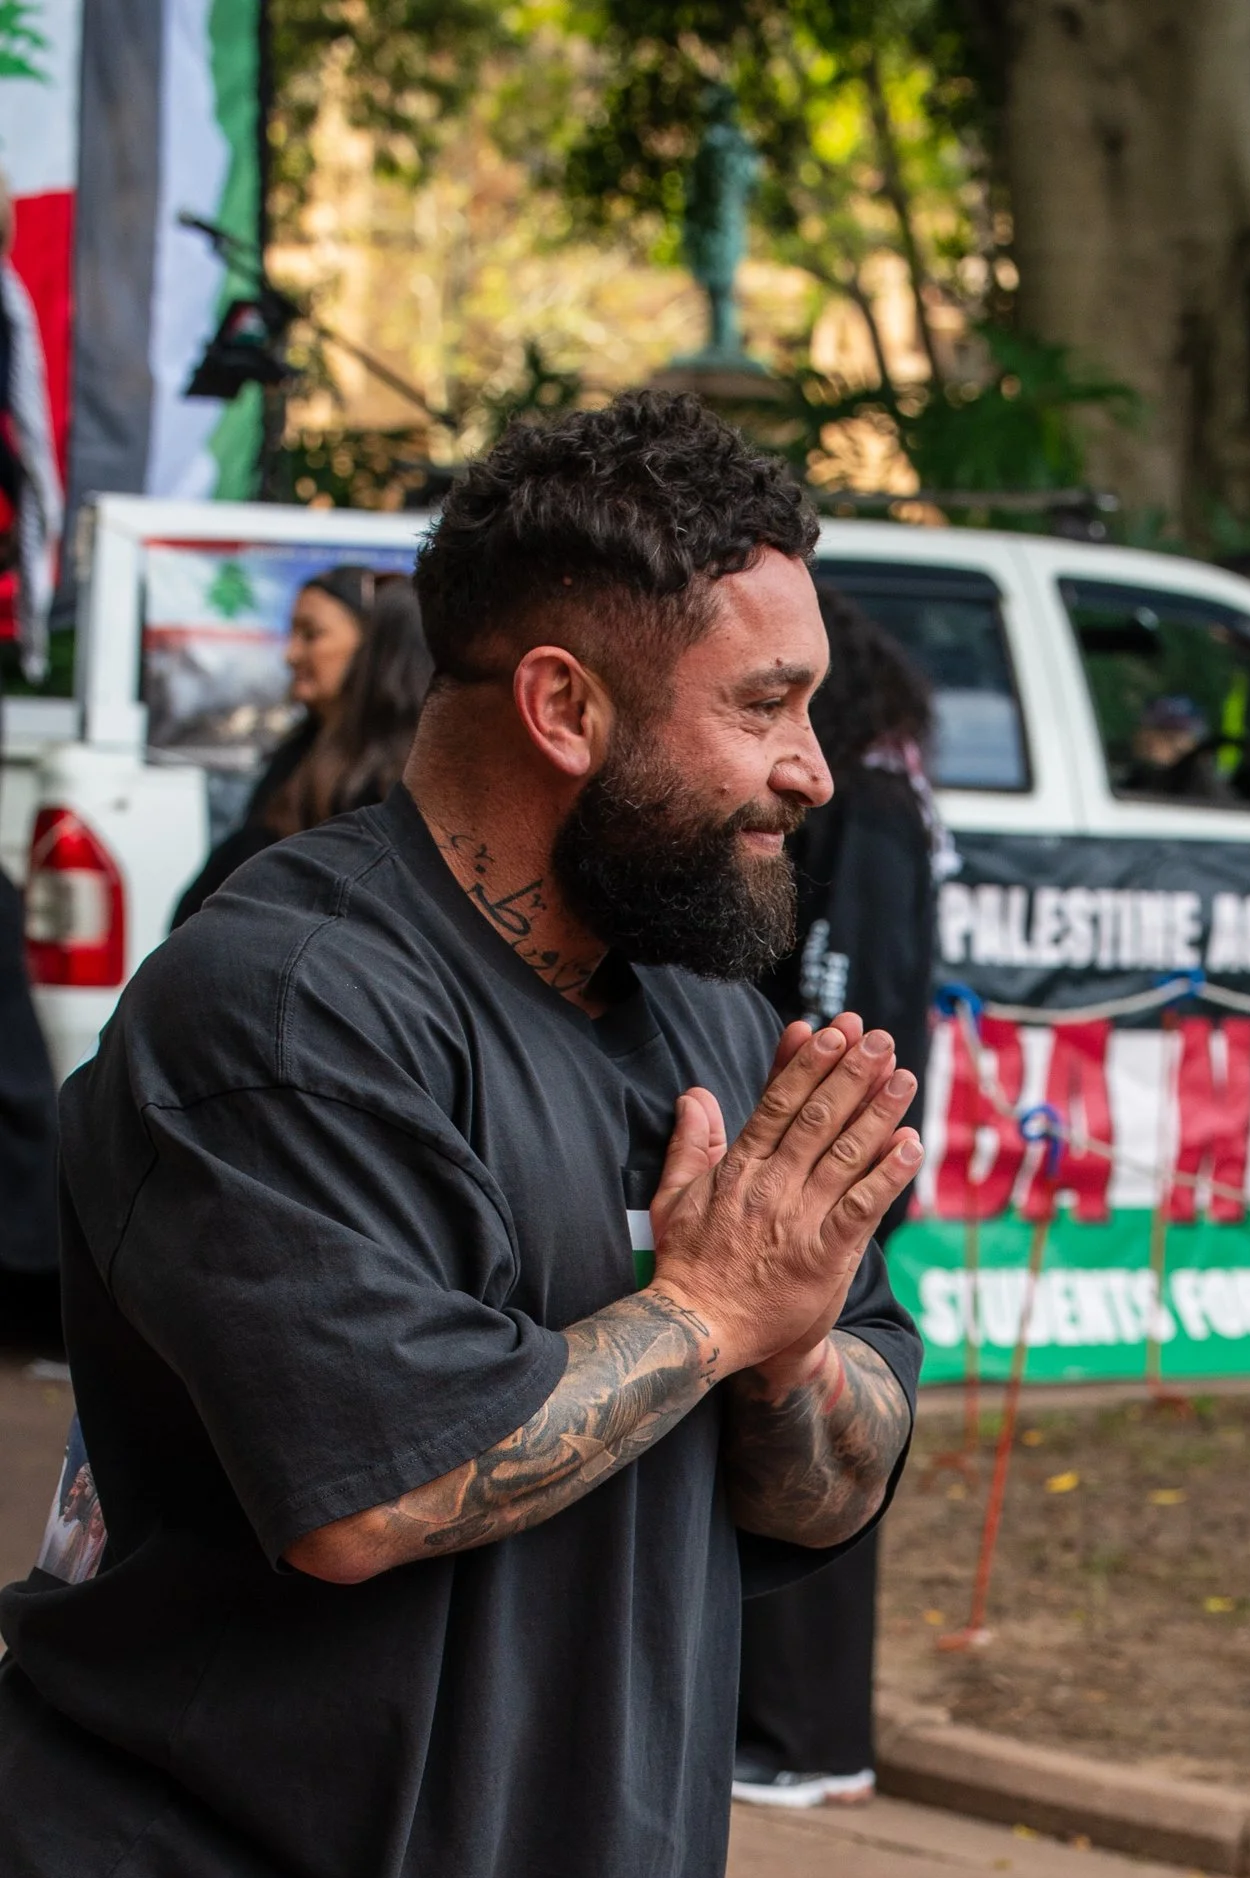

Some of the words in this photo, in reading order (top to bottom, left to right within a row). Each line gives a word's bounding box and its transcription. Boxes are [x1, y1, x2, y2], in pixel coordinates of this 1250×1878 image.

[938, 881, 1201, 970] PALESTINE
[910, 1017, 1114, 1222] BA
[919, 1266, 1177, 1348] STUDENTS
